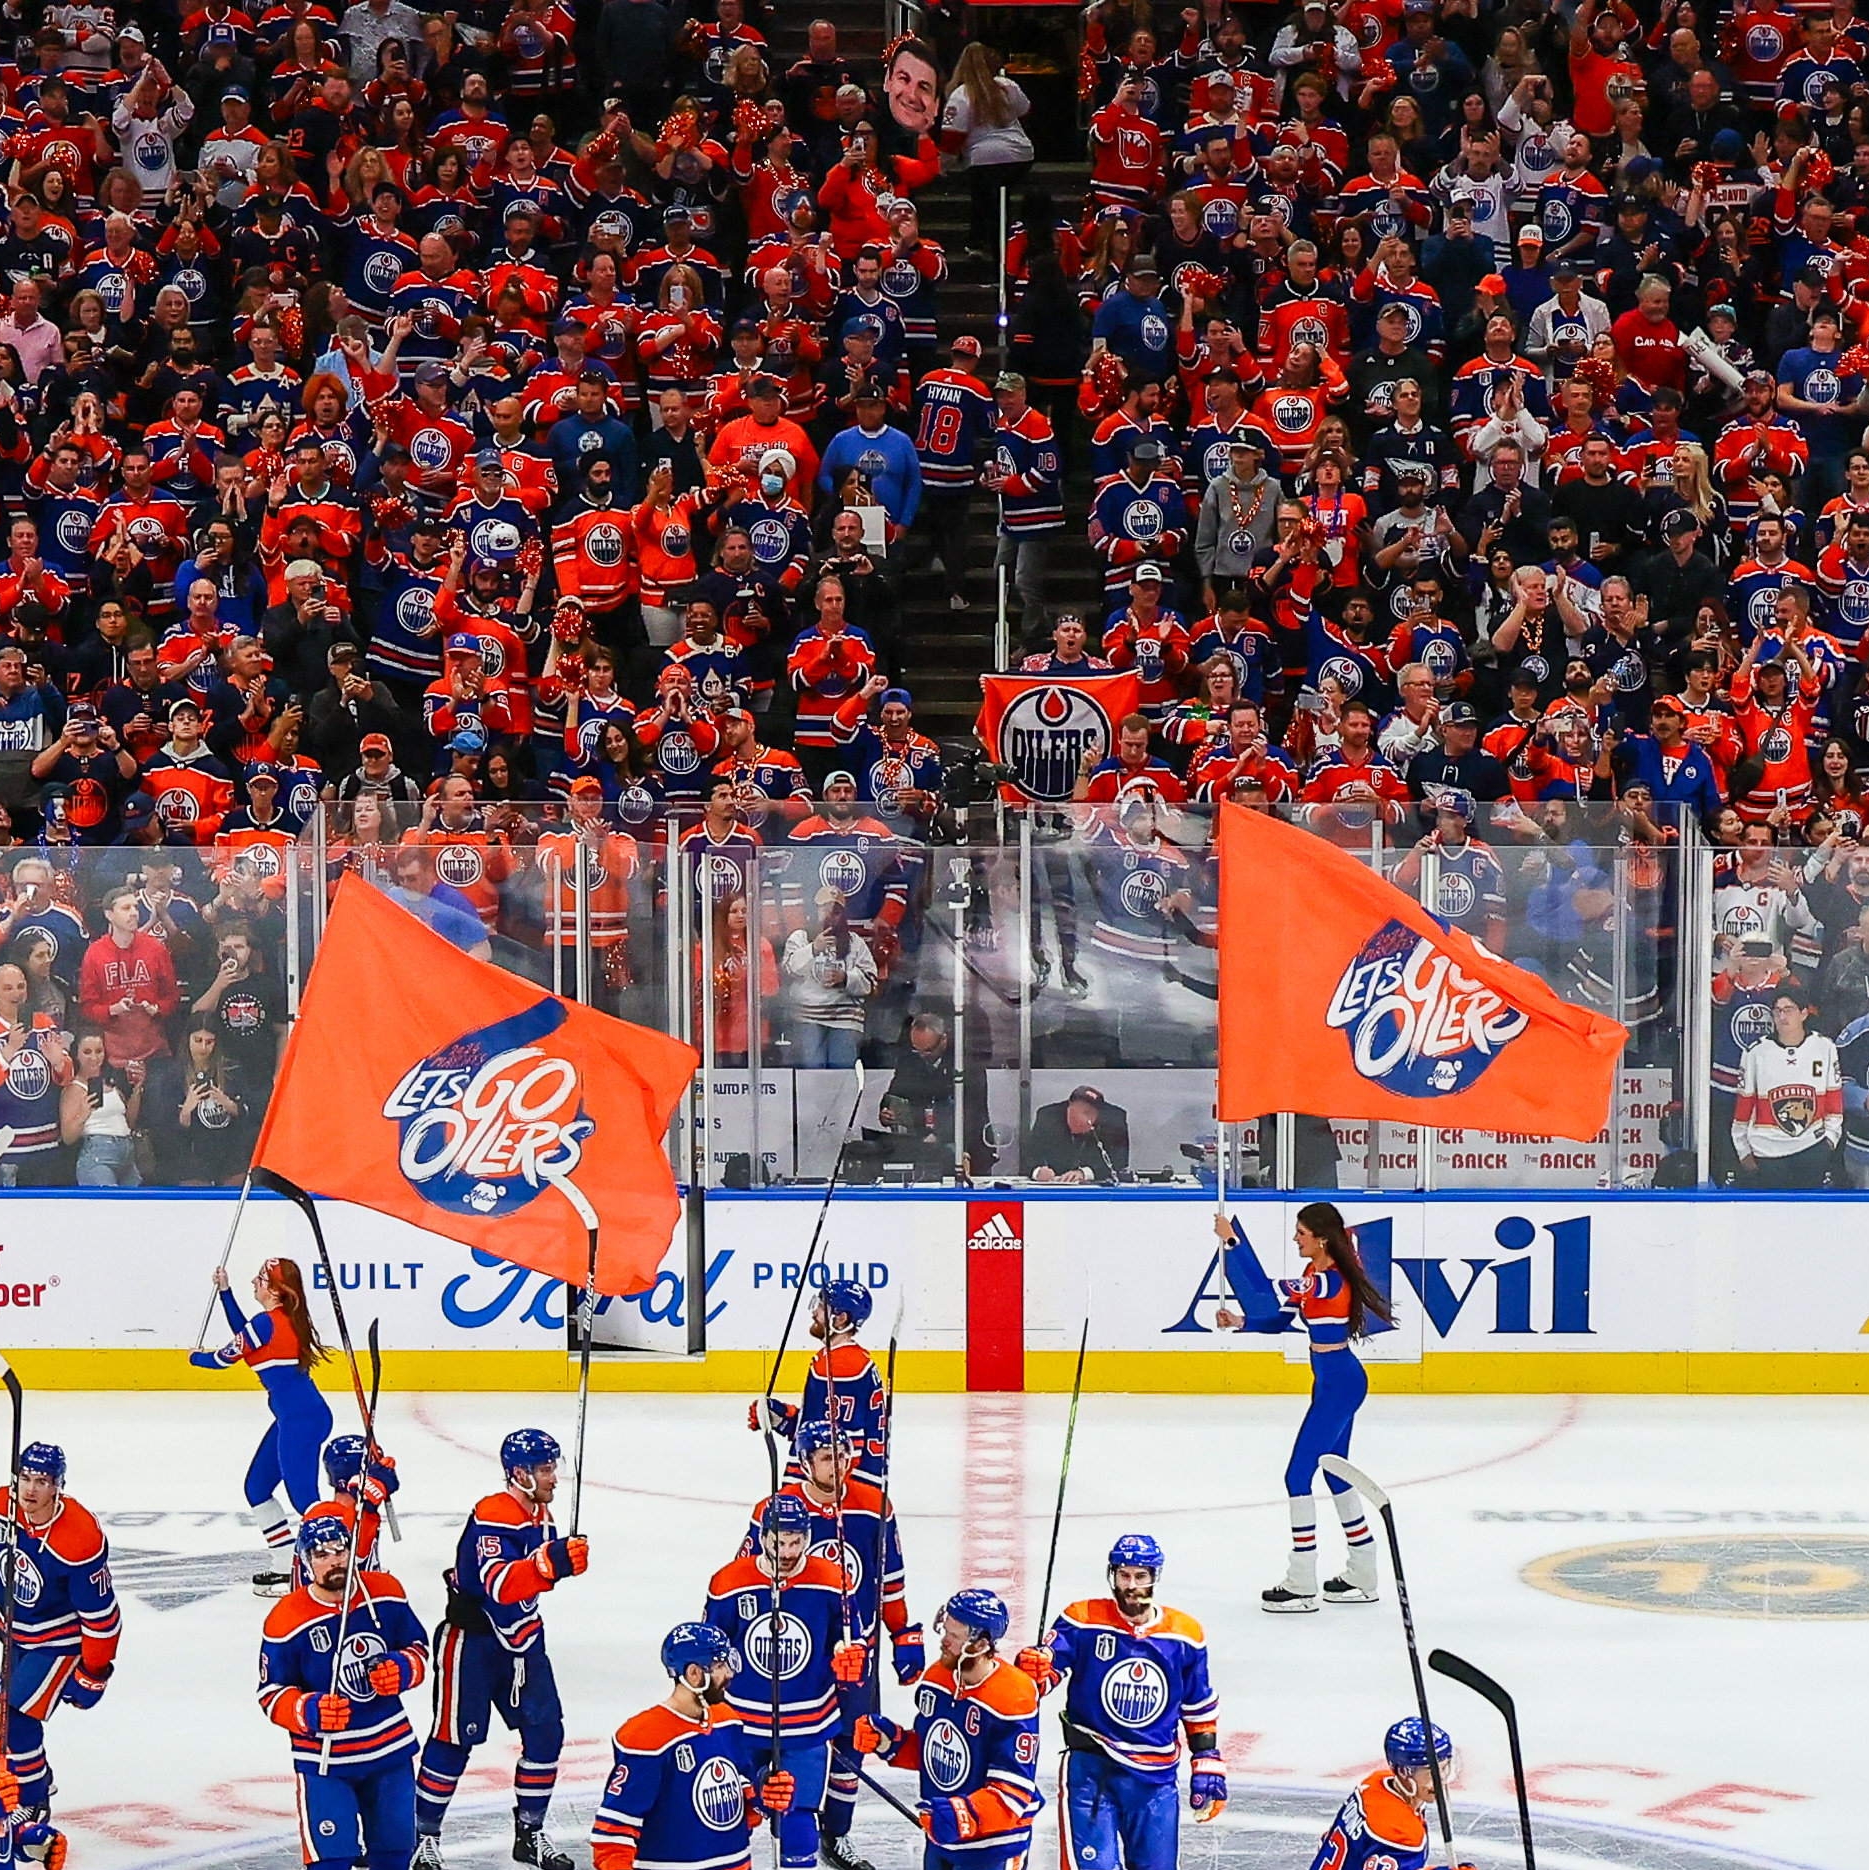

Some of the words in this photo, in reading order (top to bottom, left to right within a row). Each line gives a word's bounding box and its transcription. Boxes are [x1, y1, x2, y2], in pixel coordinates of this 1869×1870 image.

[928, 385, 962, 403] HYMAN
[918, 404, 961, 453] 18
[1036, 452, 1055, 471] 18
[1782, 711, 1792, 726] C
[911, 750, 924, 769] C
[761, 768, 773, 785] C
[1371, 769, 1383, 788] C
[860, 837, 870, 852] C
[1127, 885, 1160, 901] OILERS
[1756, 891, 1767, 907] C
[1725, 920, 1759, 934] OILERS
[103, 960, 149, 985] FLA
[1326, 953, 1403, 1028] LET'S
[11, 1067, 44, 1081] OILERS
[1812, 1061, 1822, 1078] C
[382, 1060, 470, 1120] LET'S
[462, 1046, 577, 1130] GO
[713, 1083, 740, 1095] AUTO
[399, 1110, 596, 1188] OILERS
[1451, 1153, 1508, 1169] BRICK
[1539, 1153, 1597, 1169] BRICK
[968, 1235, 1023, 1251] adidas
[313, 1262, 424, 1290] BUILT
[753, 1261, 889, 1289] PROUD
[753, 1633, 810, 1661] OILERS
[1107, 1680, 1163, 1710] OILERS
[965, 1705, 980, 1736] C
[931, 1742, 963, 1770] OILERS
[607, 1768, 627, 1794] 2
[702, 1779, 745, 1810] OILERS
[952, 1799, 971, 1839] CCM
